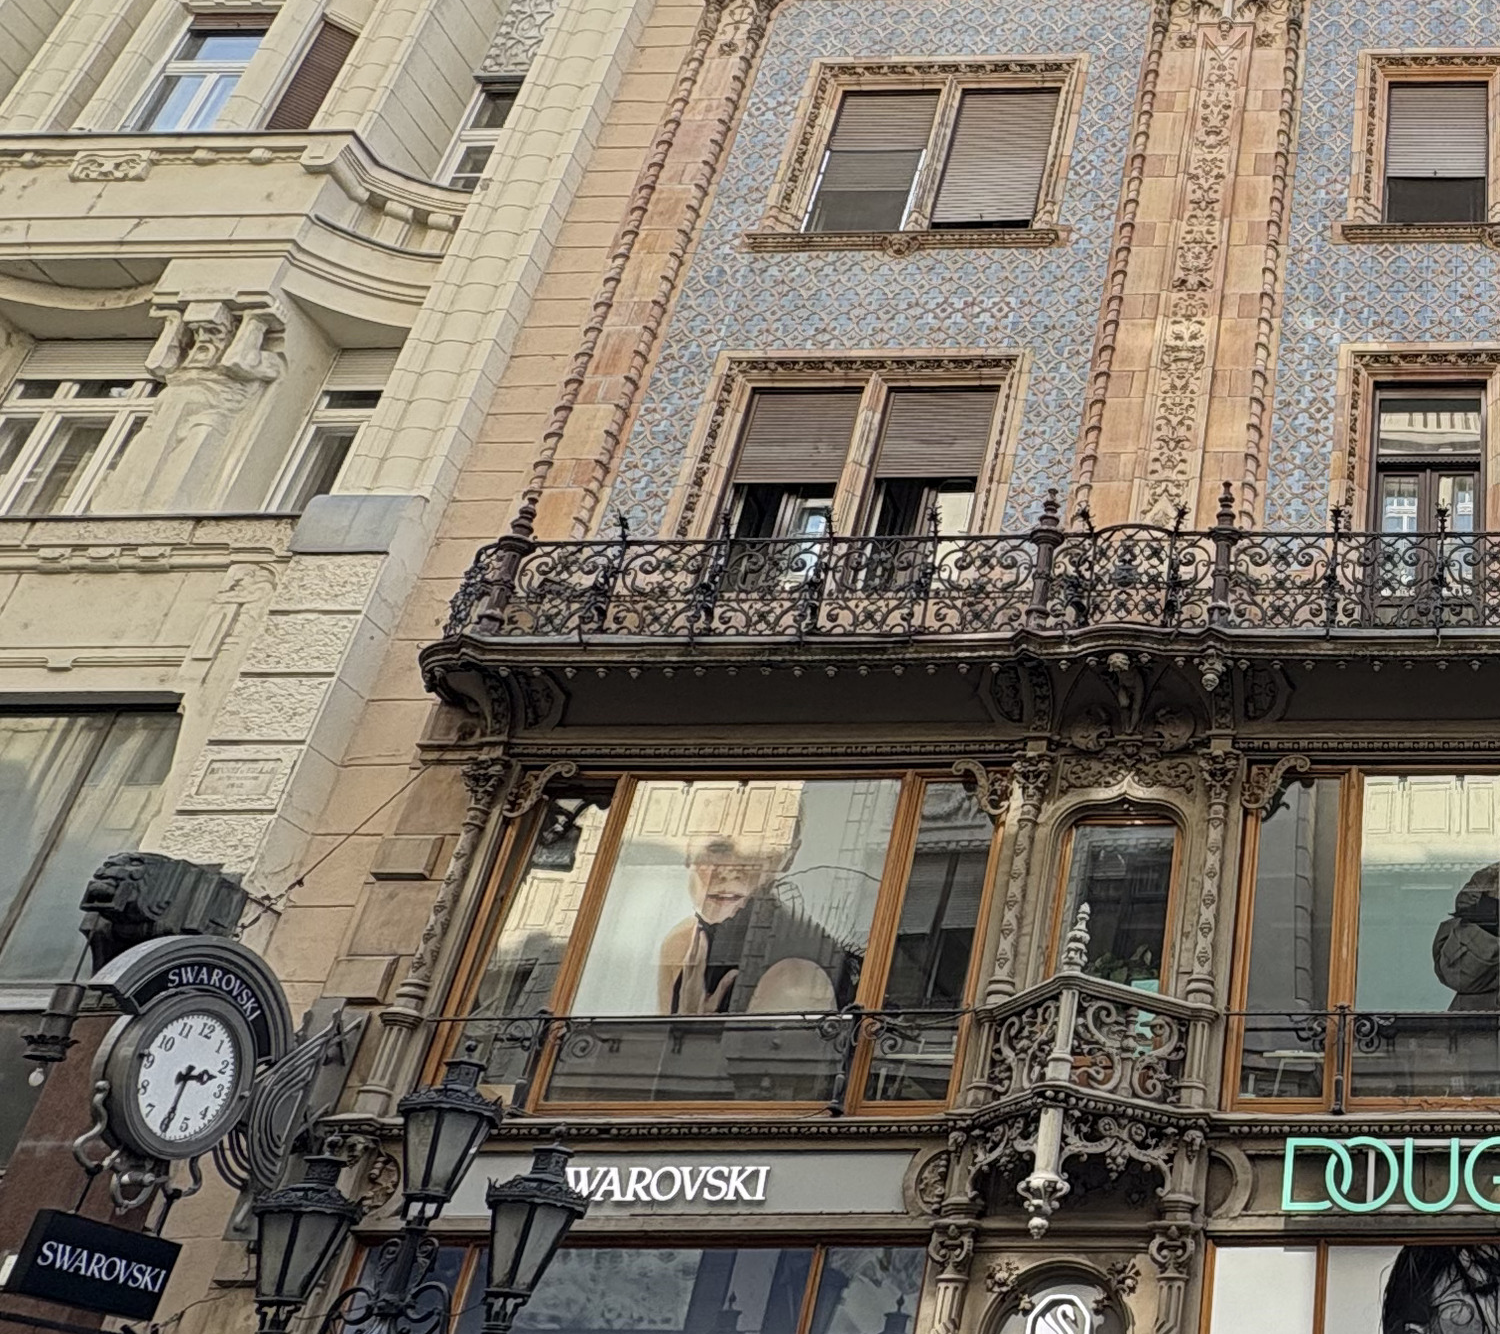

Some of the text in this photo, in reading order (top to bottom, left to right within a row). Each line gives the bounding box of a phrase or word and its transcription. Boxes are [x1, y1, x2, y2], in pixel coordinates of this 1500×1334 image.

[167, 966, 261, 1022] SWAROVSKI
[178, 1022, 193, 1039] 11
[198, 1022, 216, 1039] 12
[157, 1035, 175, 1052] 10
[215, 1039, 224, 1054] 1
[144, 1054, 155, 1069] 9
[218, 1060, 230, 1075] 2
[140, 1080, 150, 1095] 8
[213, 1084, 225, 1098] 3
[145, 1103, 155, 1118] 7
[199, 1105, 210, 1120] 4
[179, 1117, 190, 1132] 5
[566, 1166, 771, 1201] WAROVSKI
[37, 1240, 166, 1293] SWAROVSKI
